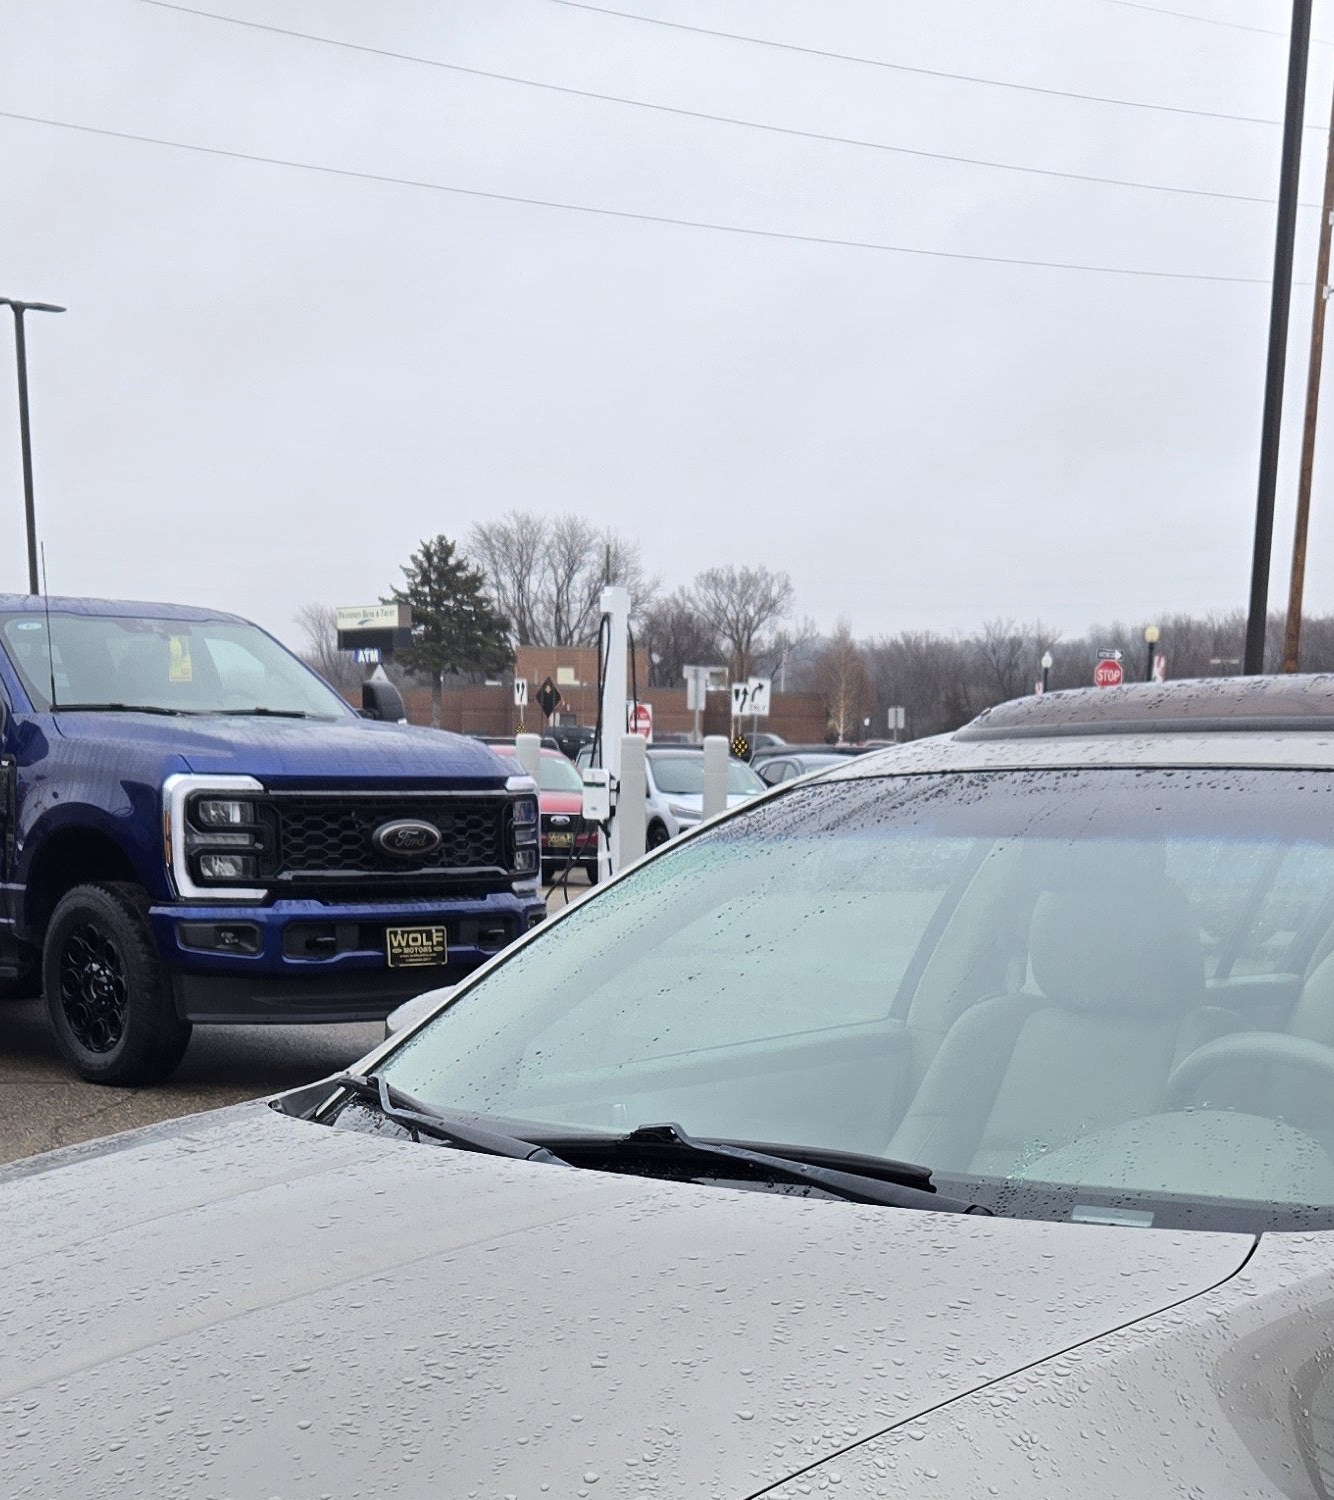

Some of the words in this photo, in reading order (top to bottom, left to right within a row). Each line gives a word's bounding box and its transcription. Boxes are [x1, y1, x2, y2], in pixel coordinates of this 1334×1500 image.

[358, 648, 378, 663] ATM
[1096, 669, 1120, 681] STOP
[395, 830, 426, 847] Ford
[391, 932, 443, 947] WOLF
